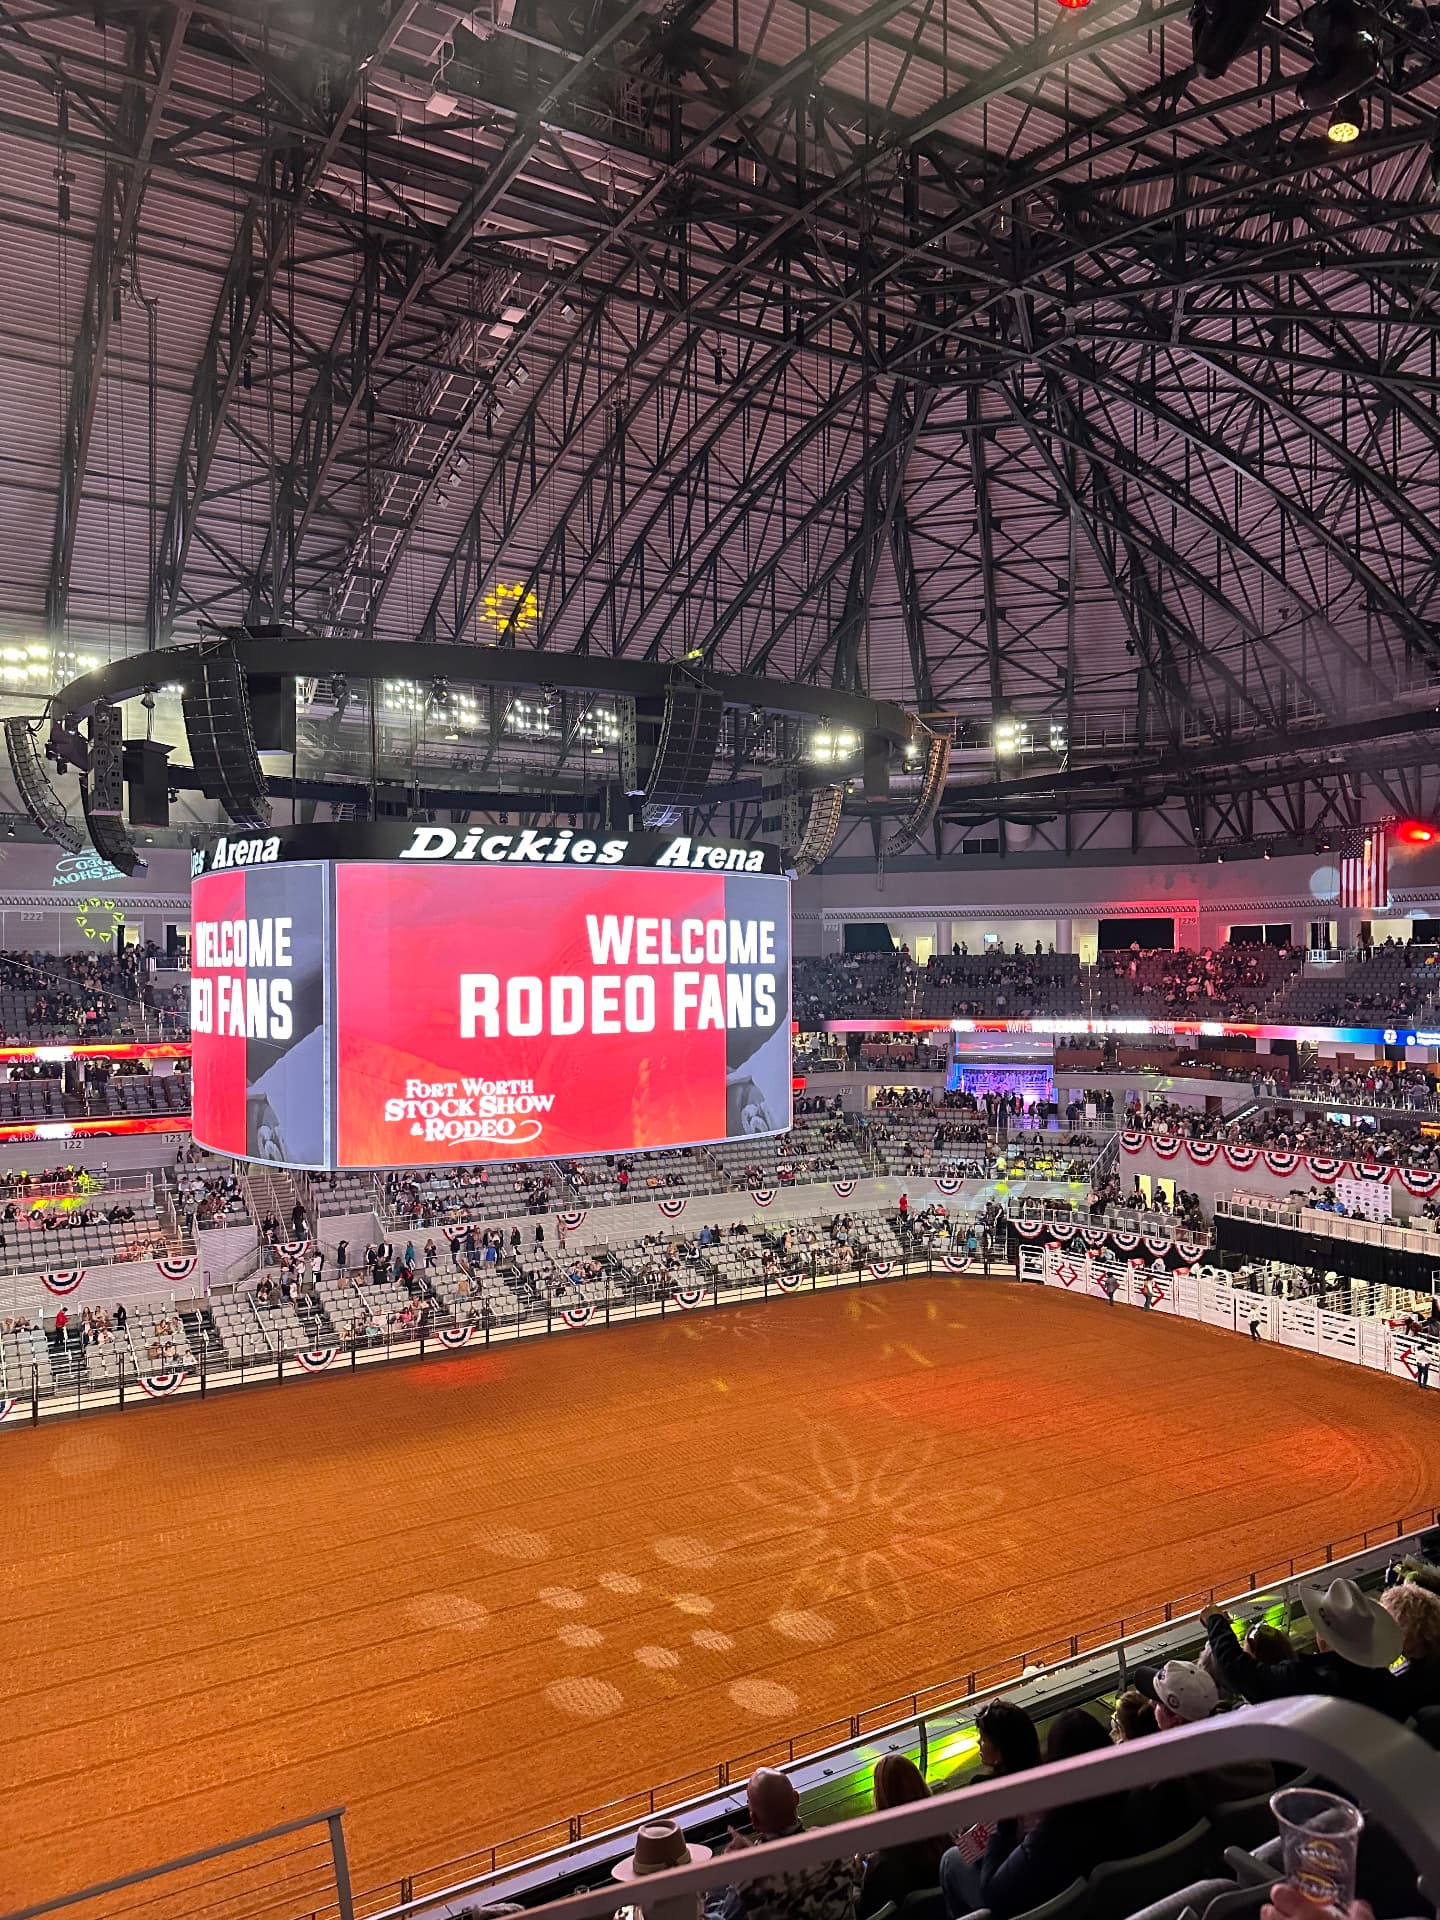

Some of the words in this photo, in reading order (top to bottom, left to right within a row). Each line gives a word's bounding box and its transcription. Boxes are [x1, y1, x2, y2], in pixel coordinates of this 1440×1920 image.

[211, 836, 281, 869] Arena
[399, 825, 628, 864] Dickies
[656, 836, 765, 872] Arena
[23, 912, 42, 921] 222
[196, 917, 292, 967] WELCOME
[586, 914, 776, 965] WELCOME
[217, 975, 292, 1040] FANS
[460, 973, 655, 1038] RODEO
[673, 971, 776, 1031] FANS
[405, 1078, 457, 1099] FORT
[461, 1077, 535, 1097] WORTH
[384, 1098, 476, 1122] STOCK
[478, 1094, 556, 1119] SHOW
[63, 1140, 83, 1149] 122
[164, 1134, 182, 1143] 123
[424, 1117, 517, 1142] RODEO
